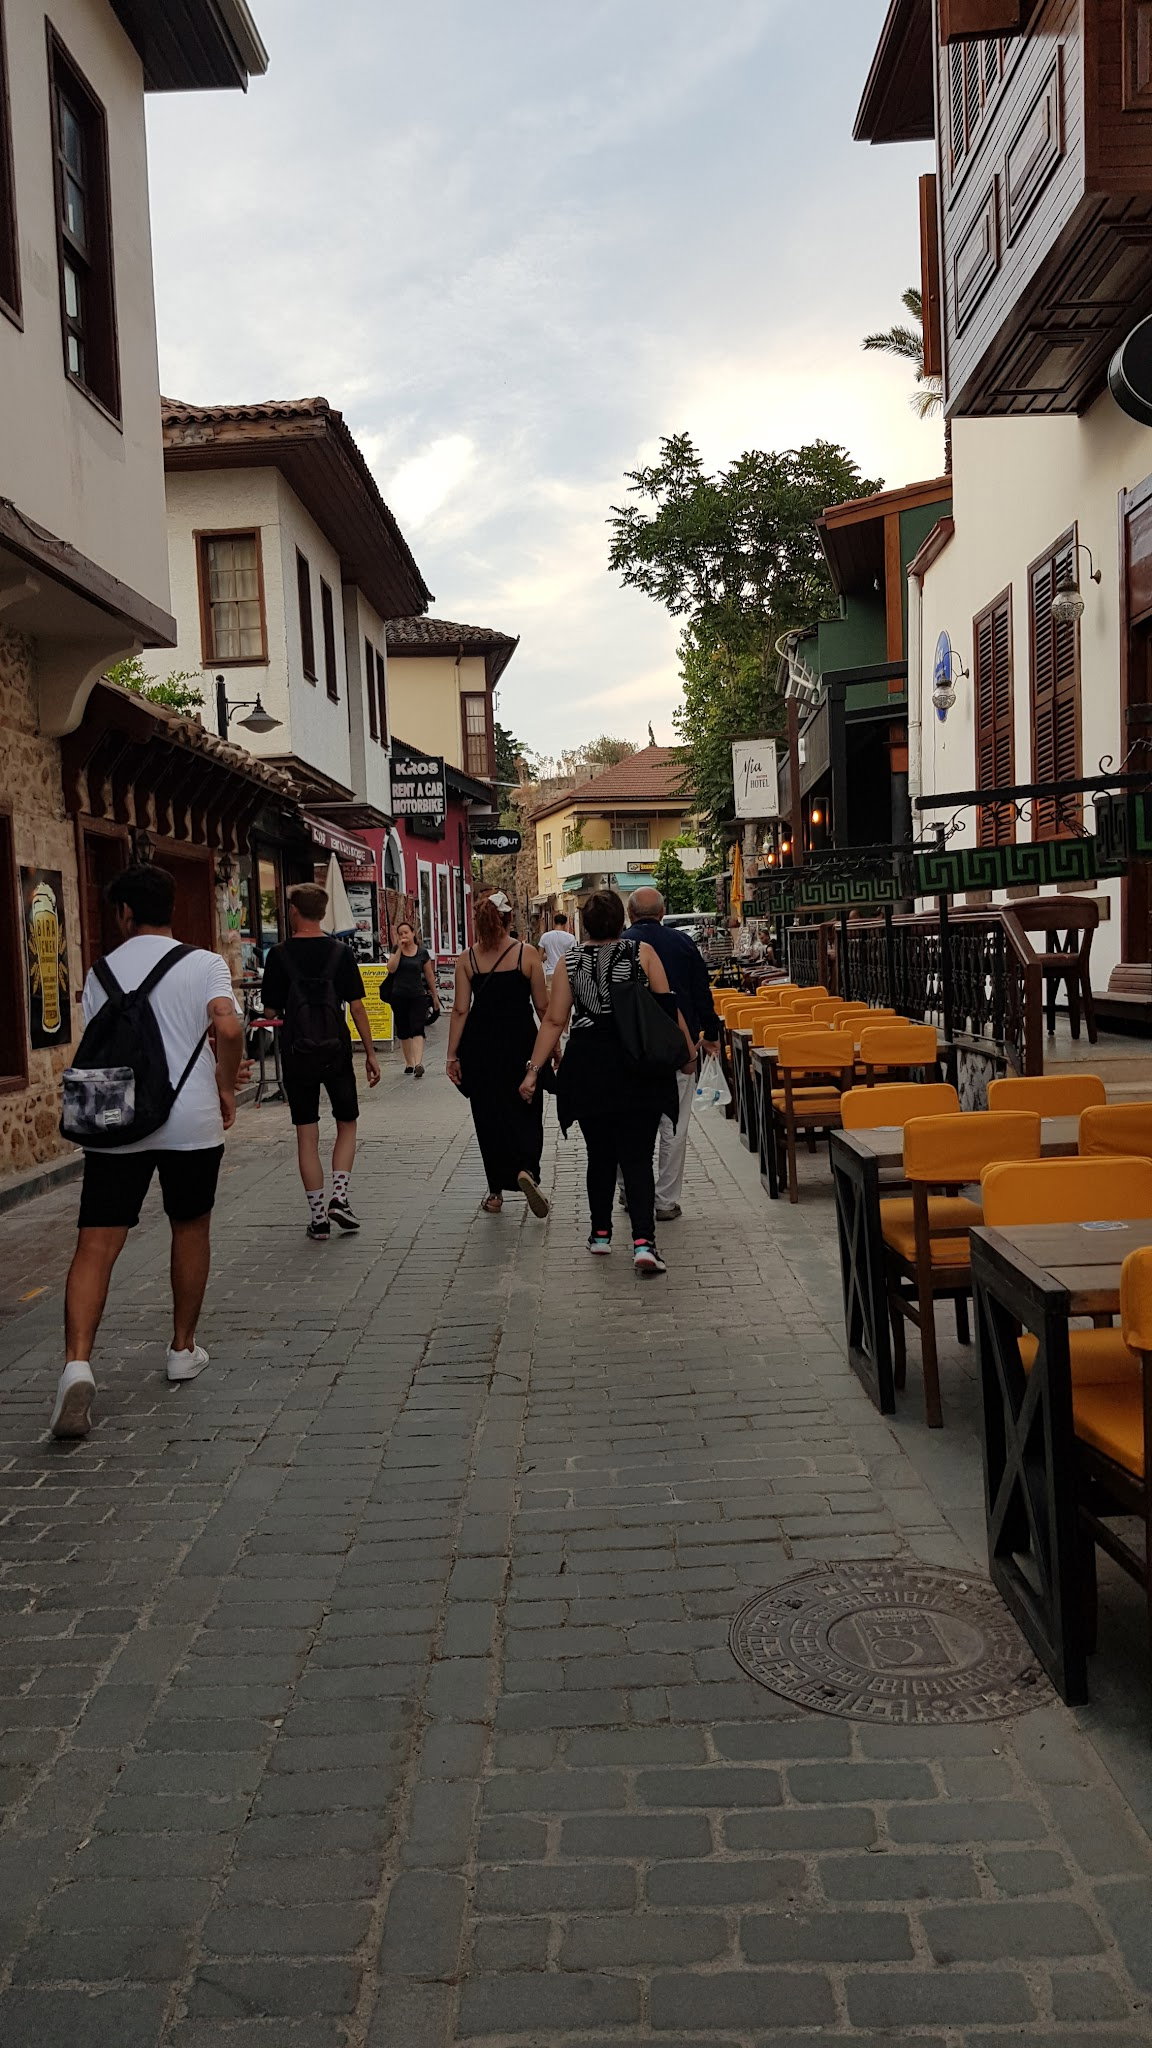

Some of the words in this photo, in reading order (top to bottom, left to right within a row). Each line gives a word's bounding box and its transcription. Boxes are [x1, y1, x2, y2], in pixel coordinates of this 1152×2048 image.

[395, 762, 439, 775] KROS
[392, 782, 415, 797] RENT
[416, 782, 424, 797] A
[424, 781, 443, 796] CAR
[750, 778, 769, 788] HOTEL
[392, 798, 444, 814] MOTORBIKE
[480, 836, 518, 848] ANGOUT
